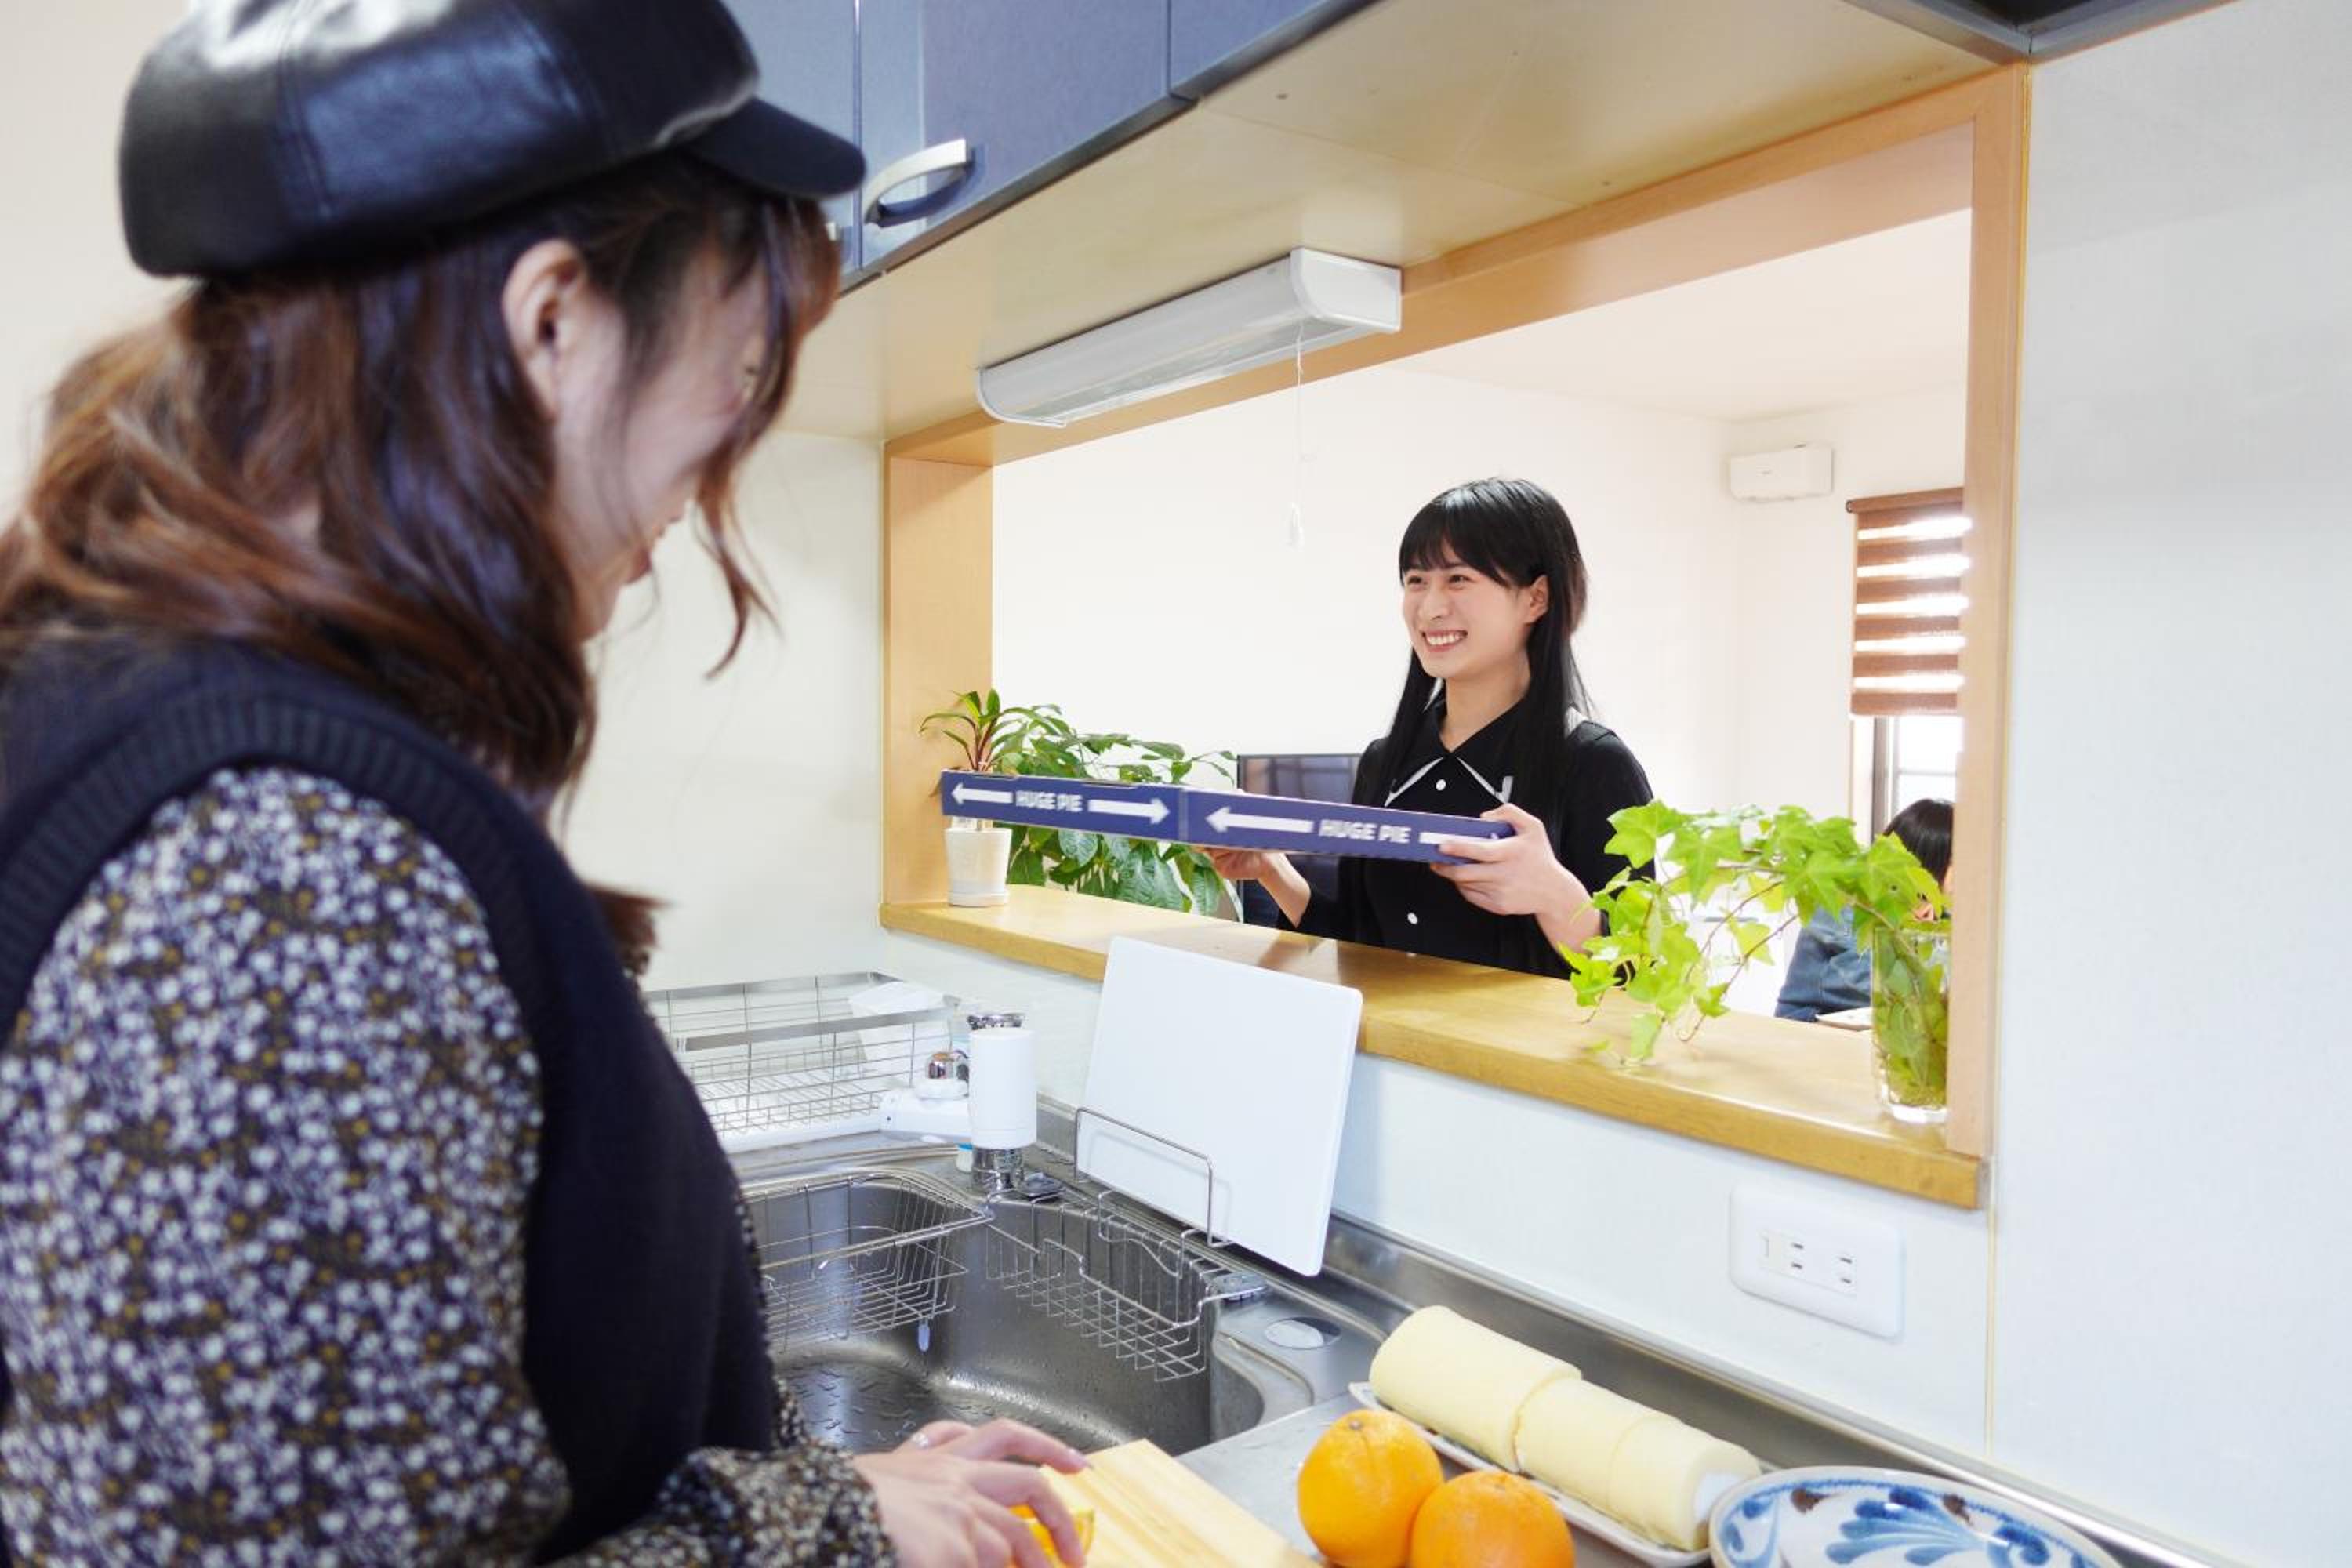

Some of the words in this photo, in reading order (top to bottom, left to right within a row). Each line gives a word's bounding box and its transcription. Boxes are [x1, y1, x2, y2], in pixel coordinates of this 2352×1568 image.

[1016, 790, 1056, 810] HUGE
[1056, 793, 1083, 812] PIE
[1319, 819, 1377, 840] HUGE
[1378, 825, 1411, 844] PIE
